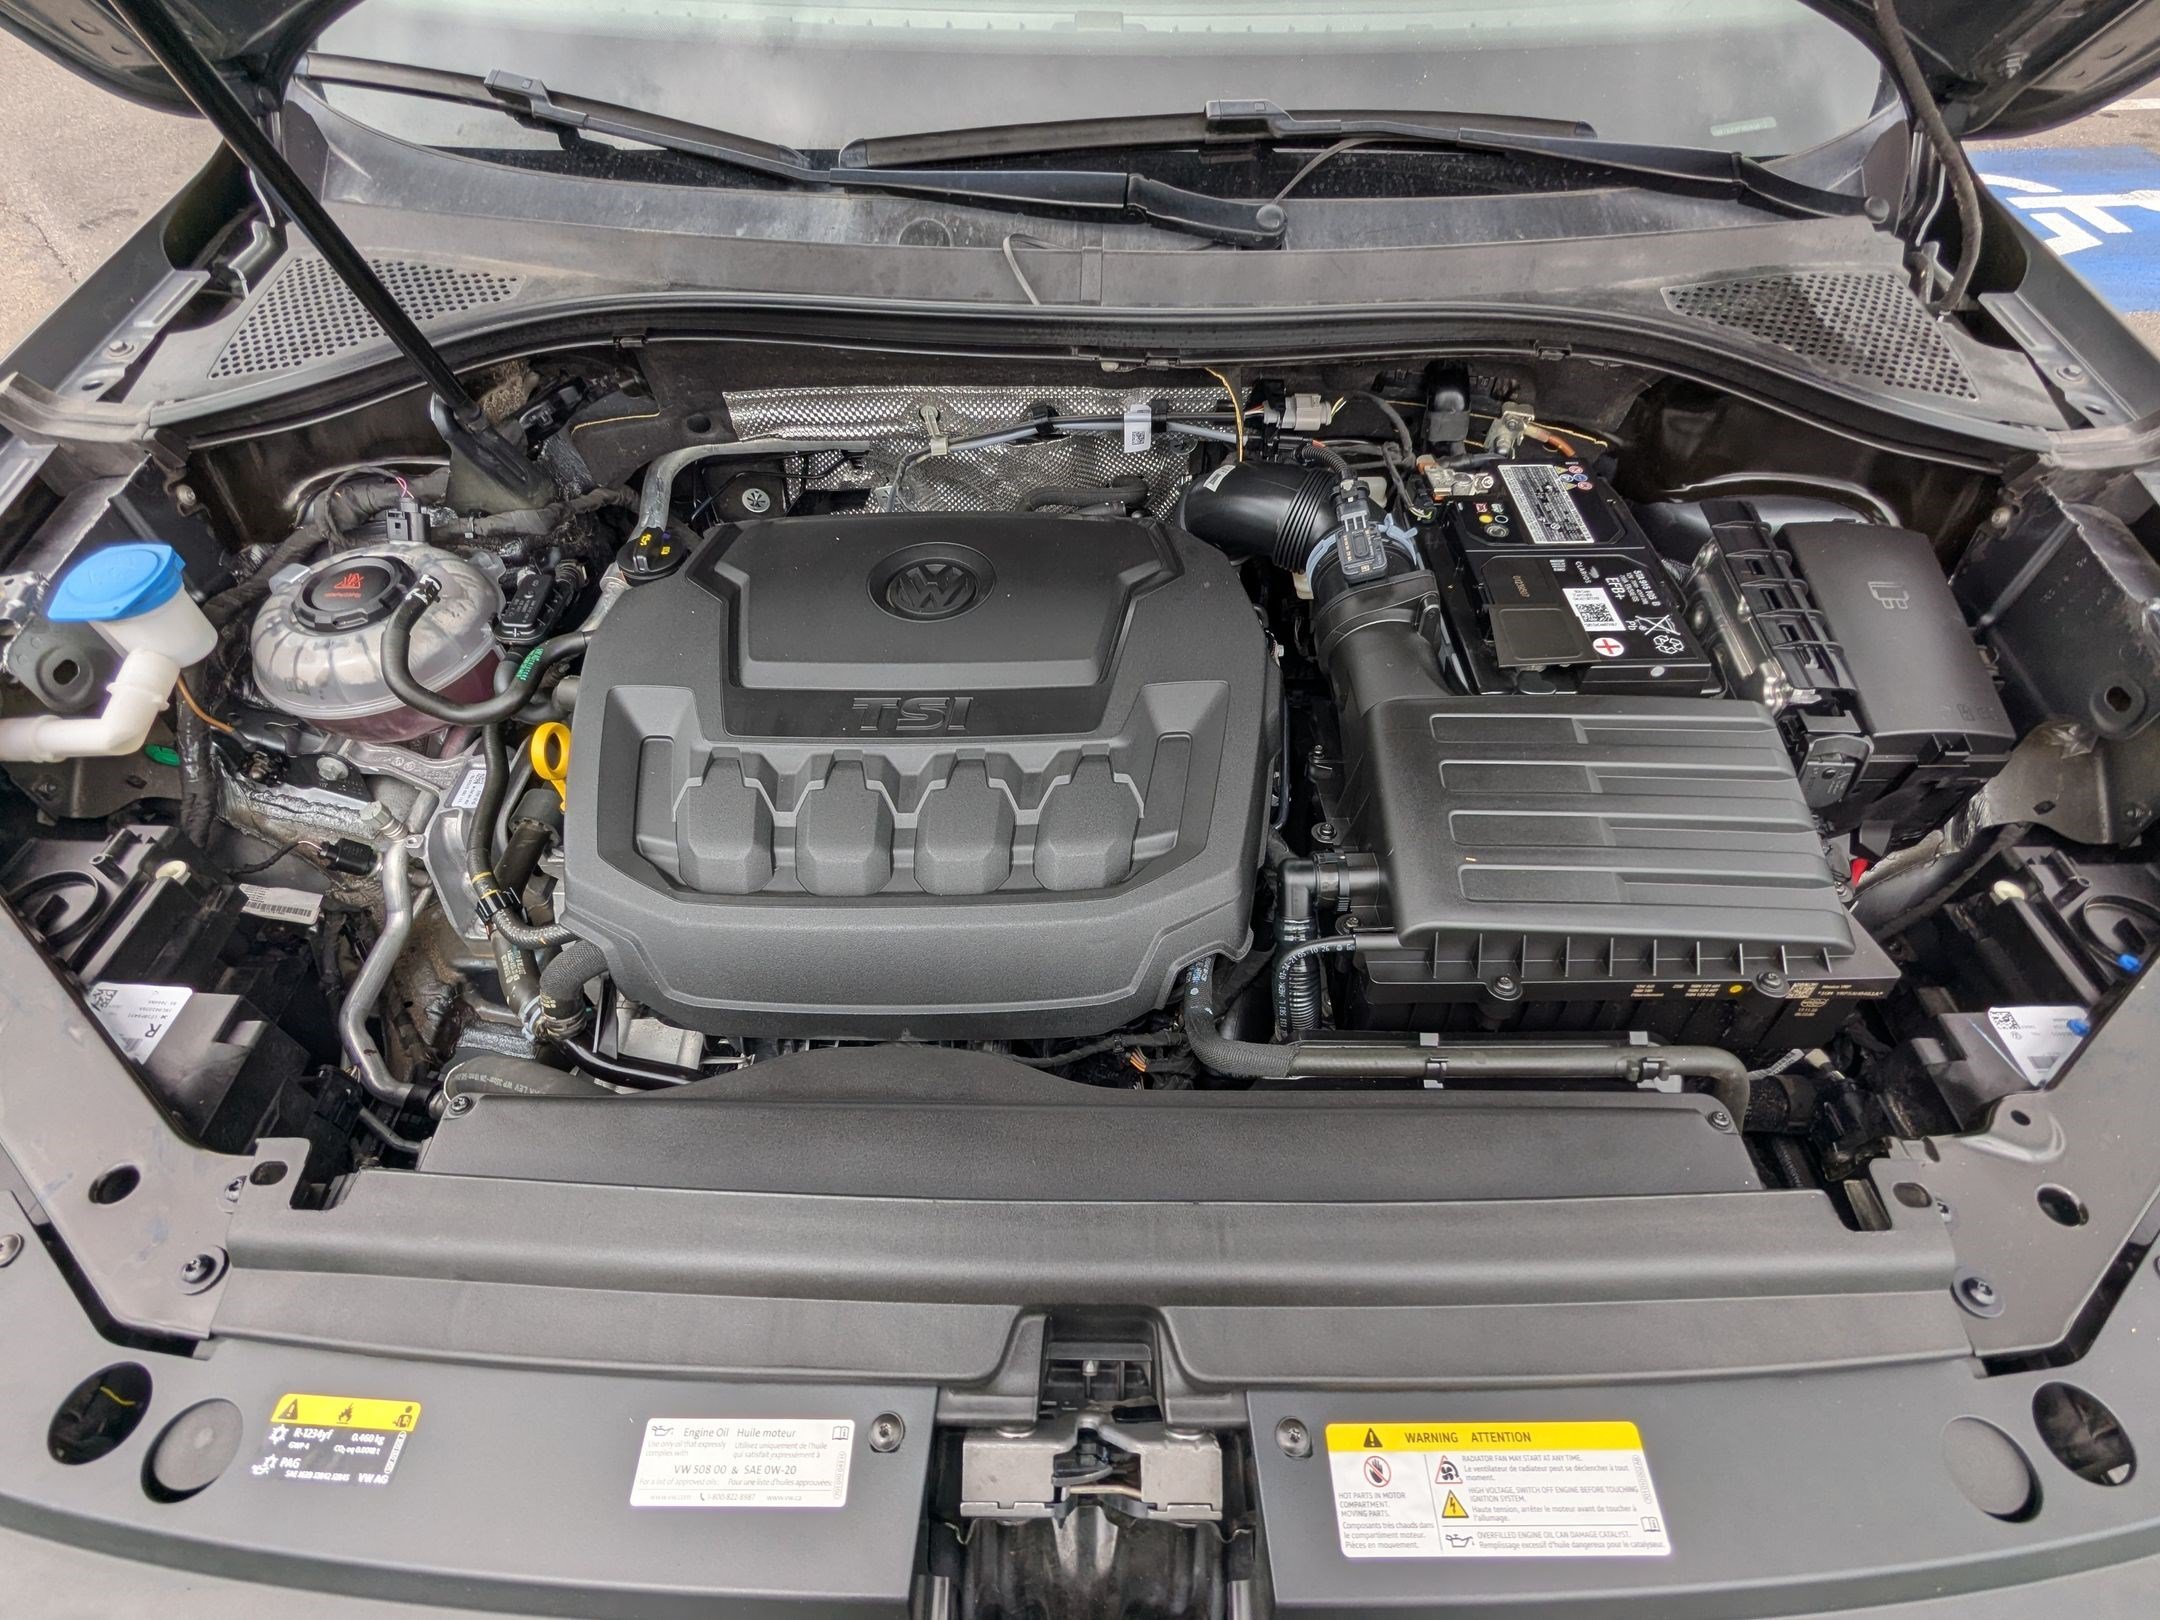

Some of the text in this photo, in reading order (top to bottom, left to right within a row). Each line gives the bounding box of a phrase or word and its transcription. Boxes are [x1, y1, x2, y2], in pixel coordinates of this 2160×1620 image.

[1575, 560, 1592, 584] CLARIOS
[1605, 577, 1625, 600] EFB+
[1625, 620, 1638, 631] Pb
[852, 696, 974, 731] TSI
[144, 1023, 162, 1039] R
[293, 1427, 334, 1441] R-1234yf
[683, 1427, 729, 1440] Engine Oil
[737, 1427, 797, 1438] Huile moteur
[1405, 1431, 1531, 1444] WARNING ATTENTION
[375, 1434, 386, 1446] kg
[280, 1457, 302, 1468] PAG
[674, 1464, 797, 1476] VW 508 00 & SAE 0W-20
[358, 1473, 389, 1485] VW AG
[1343, 1521, 1382, 1530] Composants
[1396, 1521, 1418, 1530] chauds
[1419, 1521, 1435, 1530] dans
[1351, 1531, 1399, 1539] compartiment
[1477, 1531, 1517, 1539] OVERFILLED
[1518, 1531, 1542, 1539] ENGINE
[1543, 1531, 1554, 1539] OIL
[1555, 1531, 1569, 1539] CAN
[1570, 1531, 1598, 1539] DAMAGE
[1368, 1541, 1376, 1549] en
[1479, 1541, 1520, 1550] Remplissage
[1607, 1541, 1622, 1550] pour
